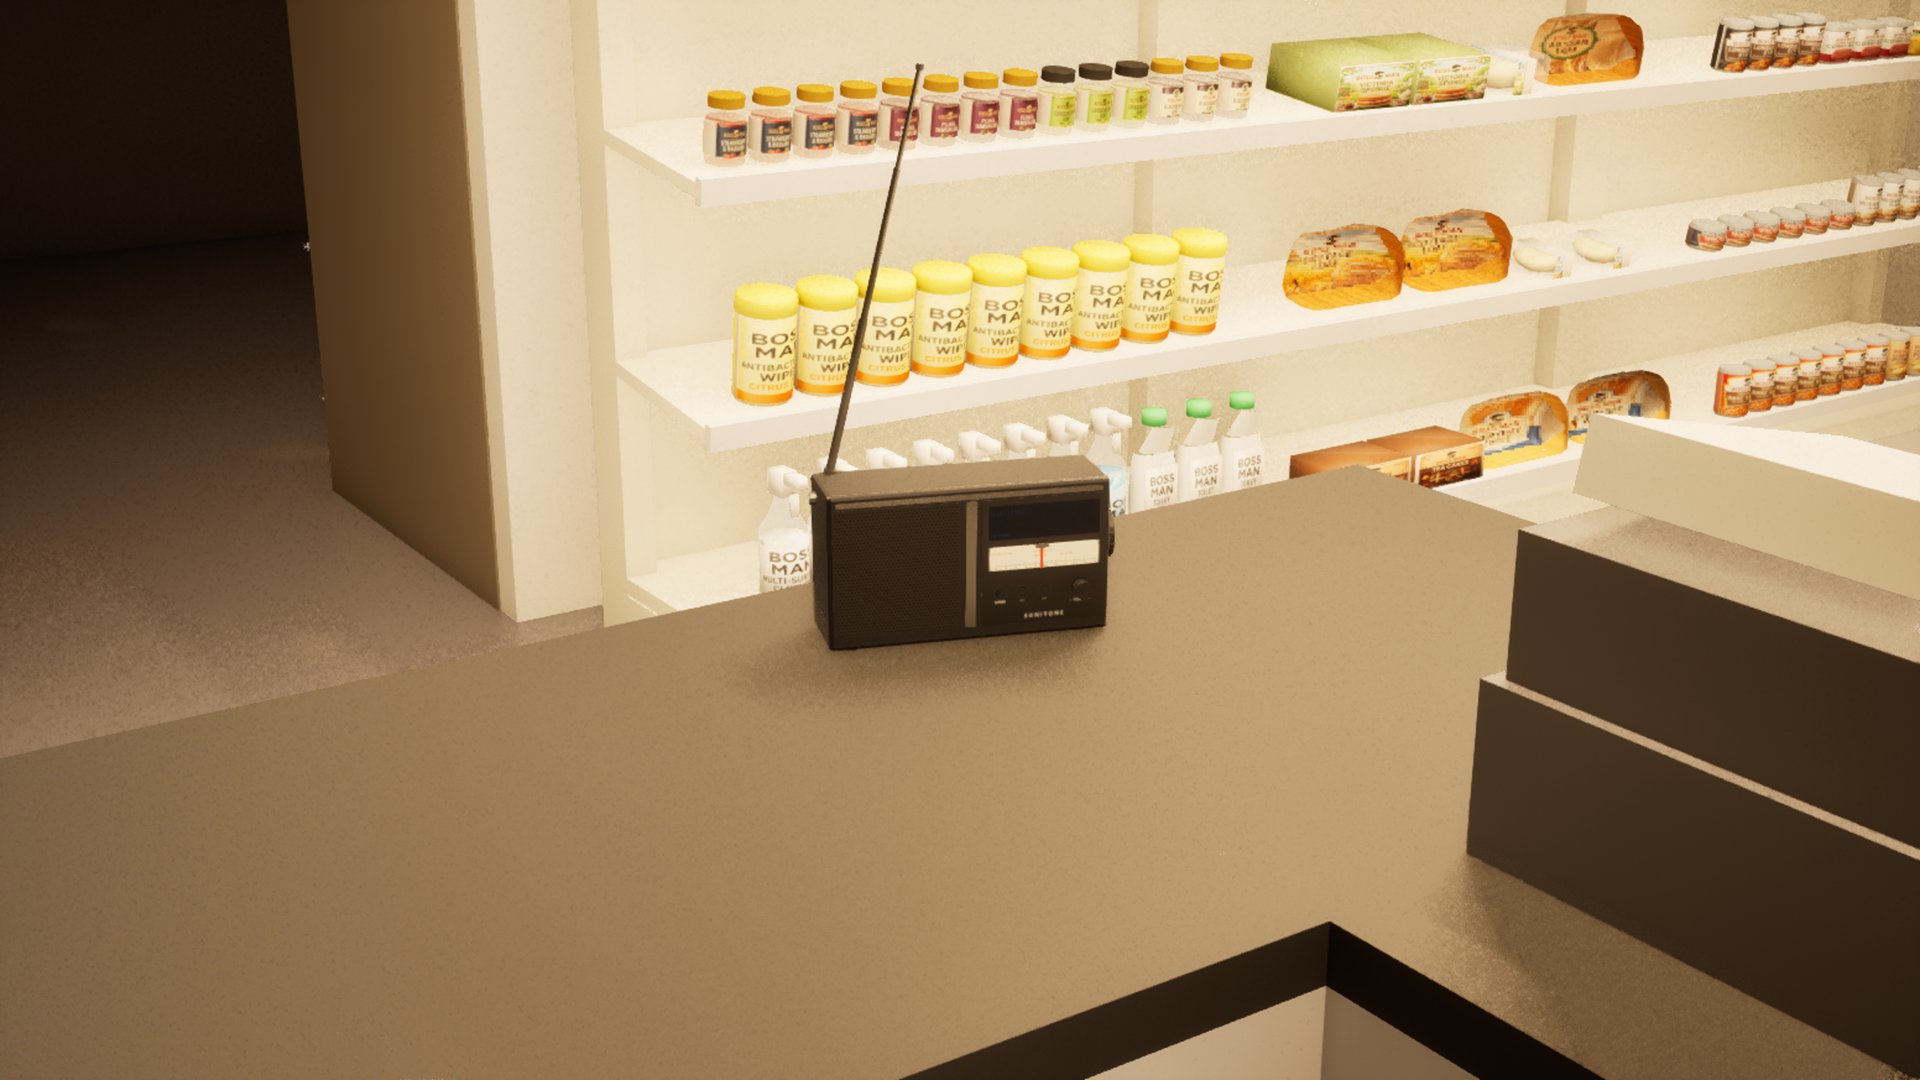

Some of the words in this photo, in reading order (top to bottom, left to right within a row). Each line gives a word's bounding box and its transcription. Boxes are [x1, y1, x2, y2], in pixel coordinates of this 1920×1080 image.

[1143, 288, 1173, 301] MA
[1190, 281, 1221, 295] MA
[1092, 296, 1124, 309] MA
[1041, 303, 1073, 316] MA
[987, 311, 1021, 324] MA
[932, 320, 967, 333] MA
[875, 328, 910, 341] MA
[816, 336, 853, 349] MA
[755, 343, 794, 359] MA
[1238, 455, 1261, 468] BOSS
[1194, 464, 1218, 477] BOSS
[1238, 466, 1260, 479] MAN
[1150, 473, 1175, 487] BOSS
[1194, 475, 1217, 488] MAN
[1150, 484, 1173, 498] MAN
[768, 549, 809, 563] BOS
